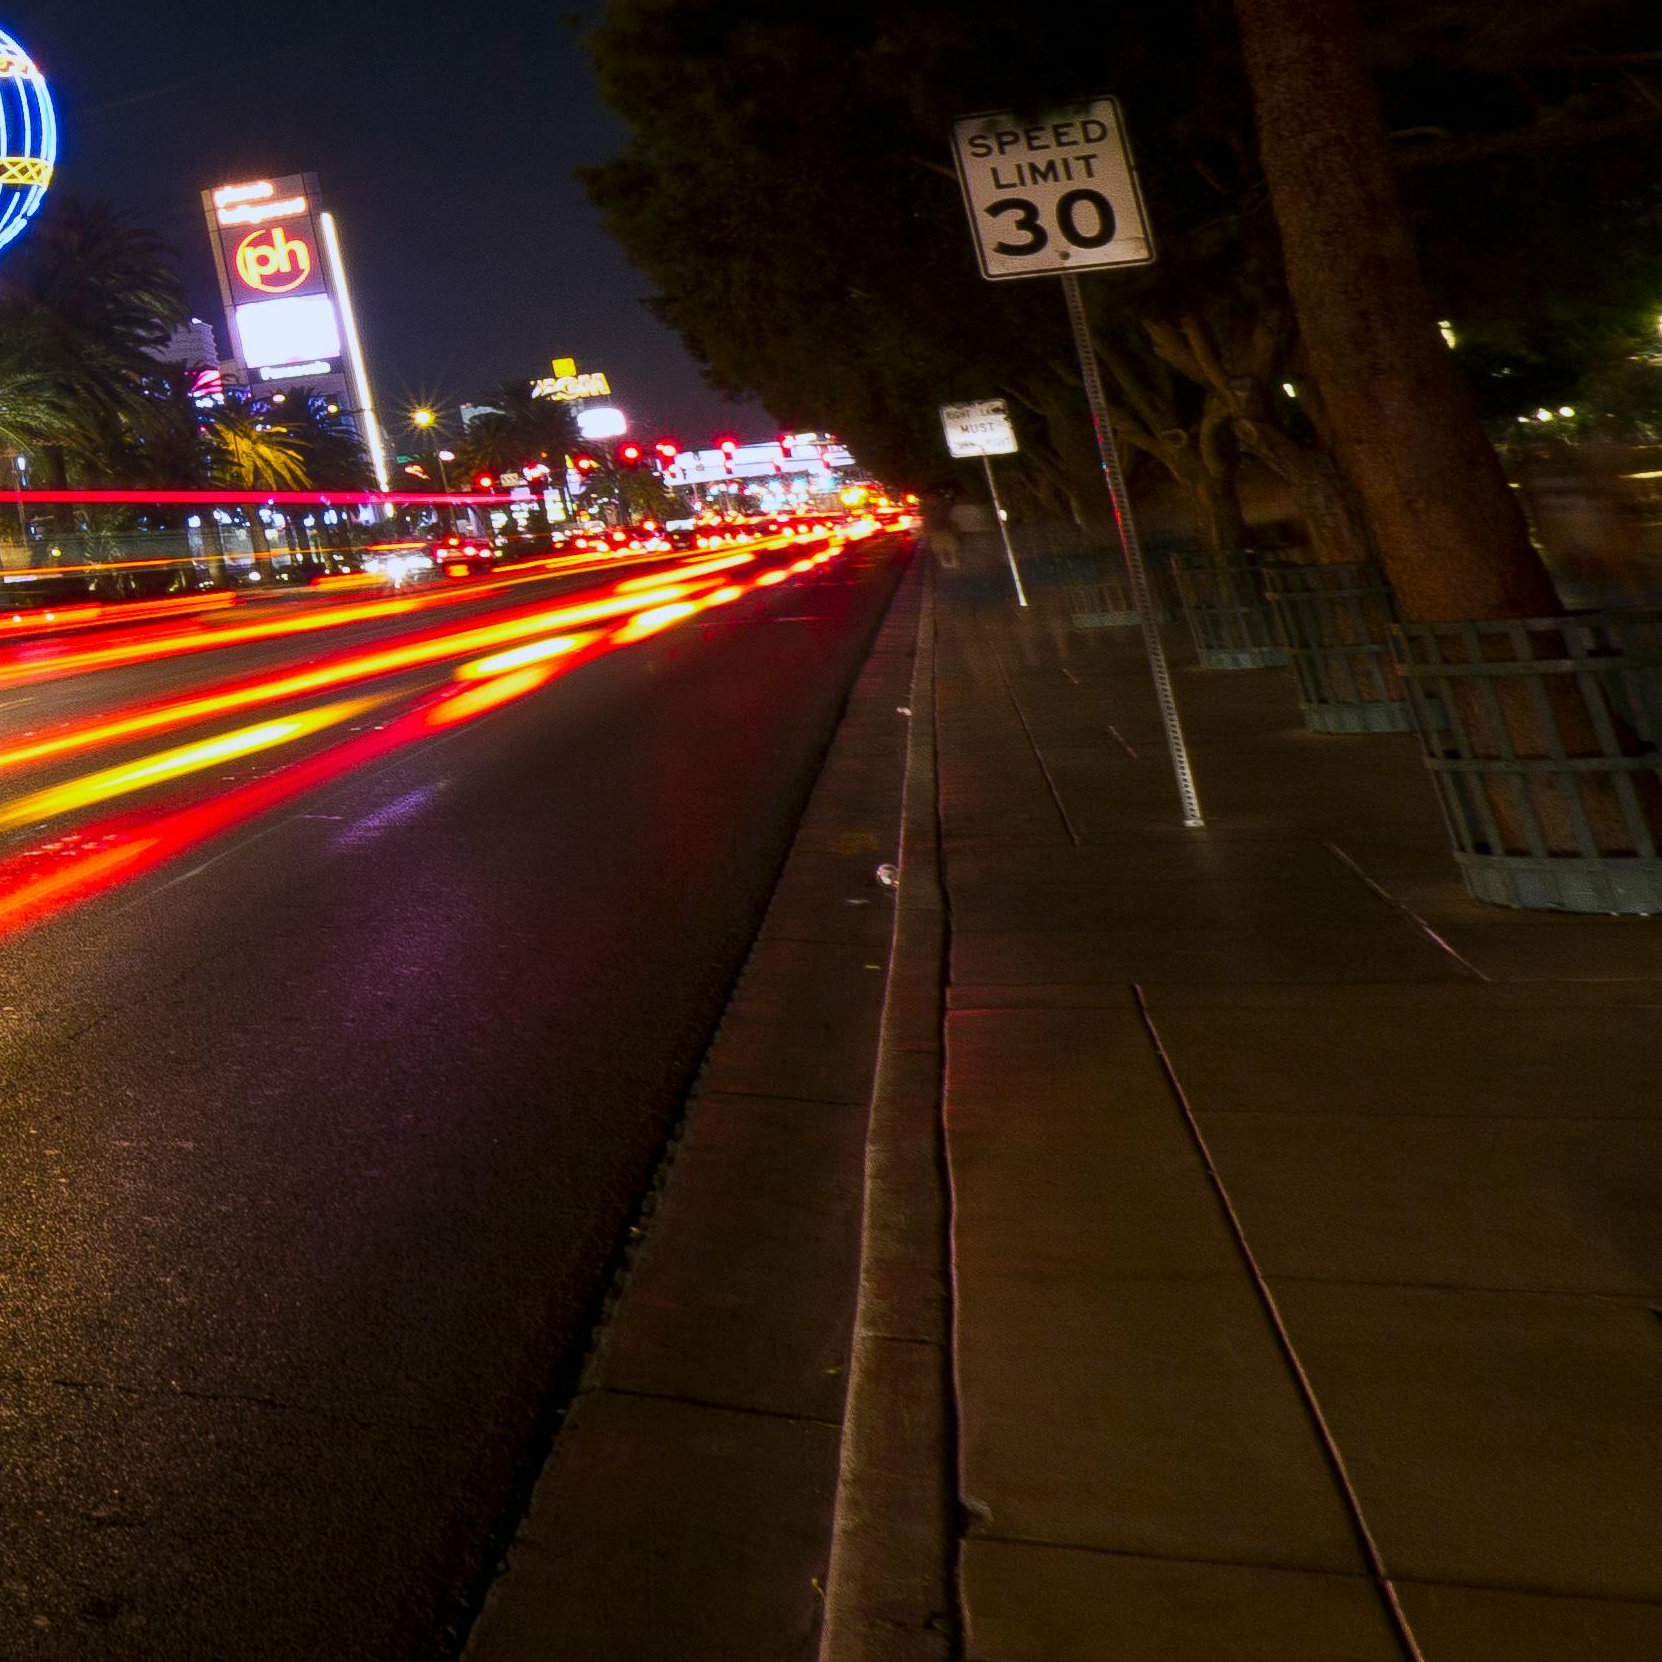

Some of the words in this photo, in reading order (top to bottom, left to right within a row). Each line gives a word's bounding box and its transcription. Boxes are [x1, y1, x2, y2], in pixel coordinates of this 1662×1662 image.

[966, 119, 1109, 158] SPEED
[990, 154, 1099, 190] LIMIT
[983, 188, 1117, 257] 30
[959, 421, 995, 434] MUST
